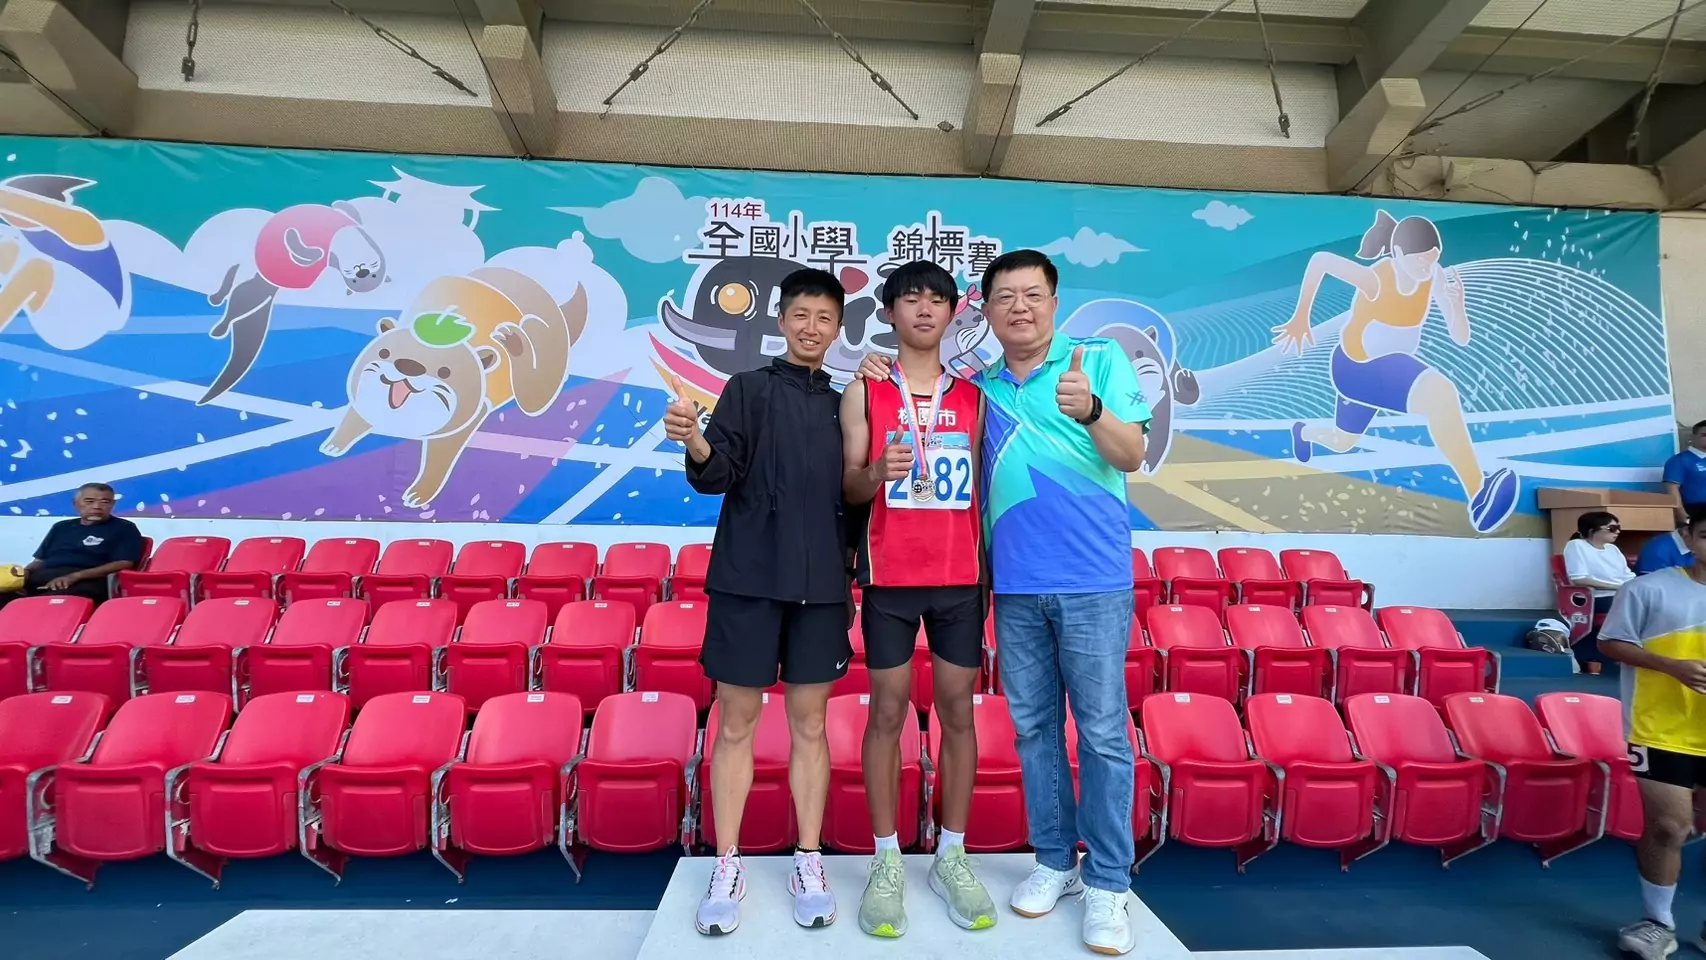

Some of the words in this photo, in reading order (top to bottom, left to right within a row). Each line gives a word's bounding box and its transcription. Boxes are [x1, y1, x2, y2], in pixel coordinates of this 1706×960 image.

[711, 202, 762, 220] 114年
[688, 216, 867, 275] 全國小學
[889, 216, 997, 277] 錦標賽
